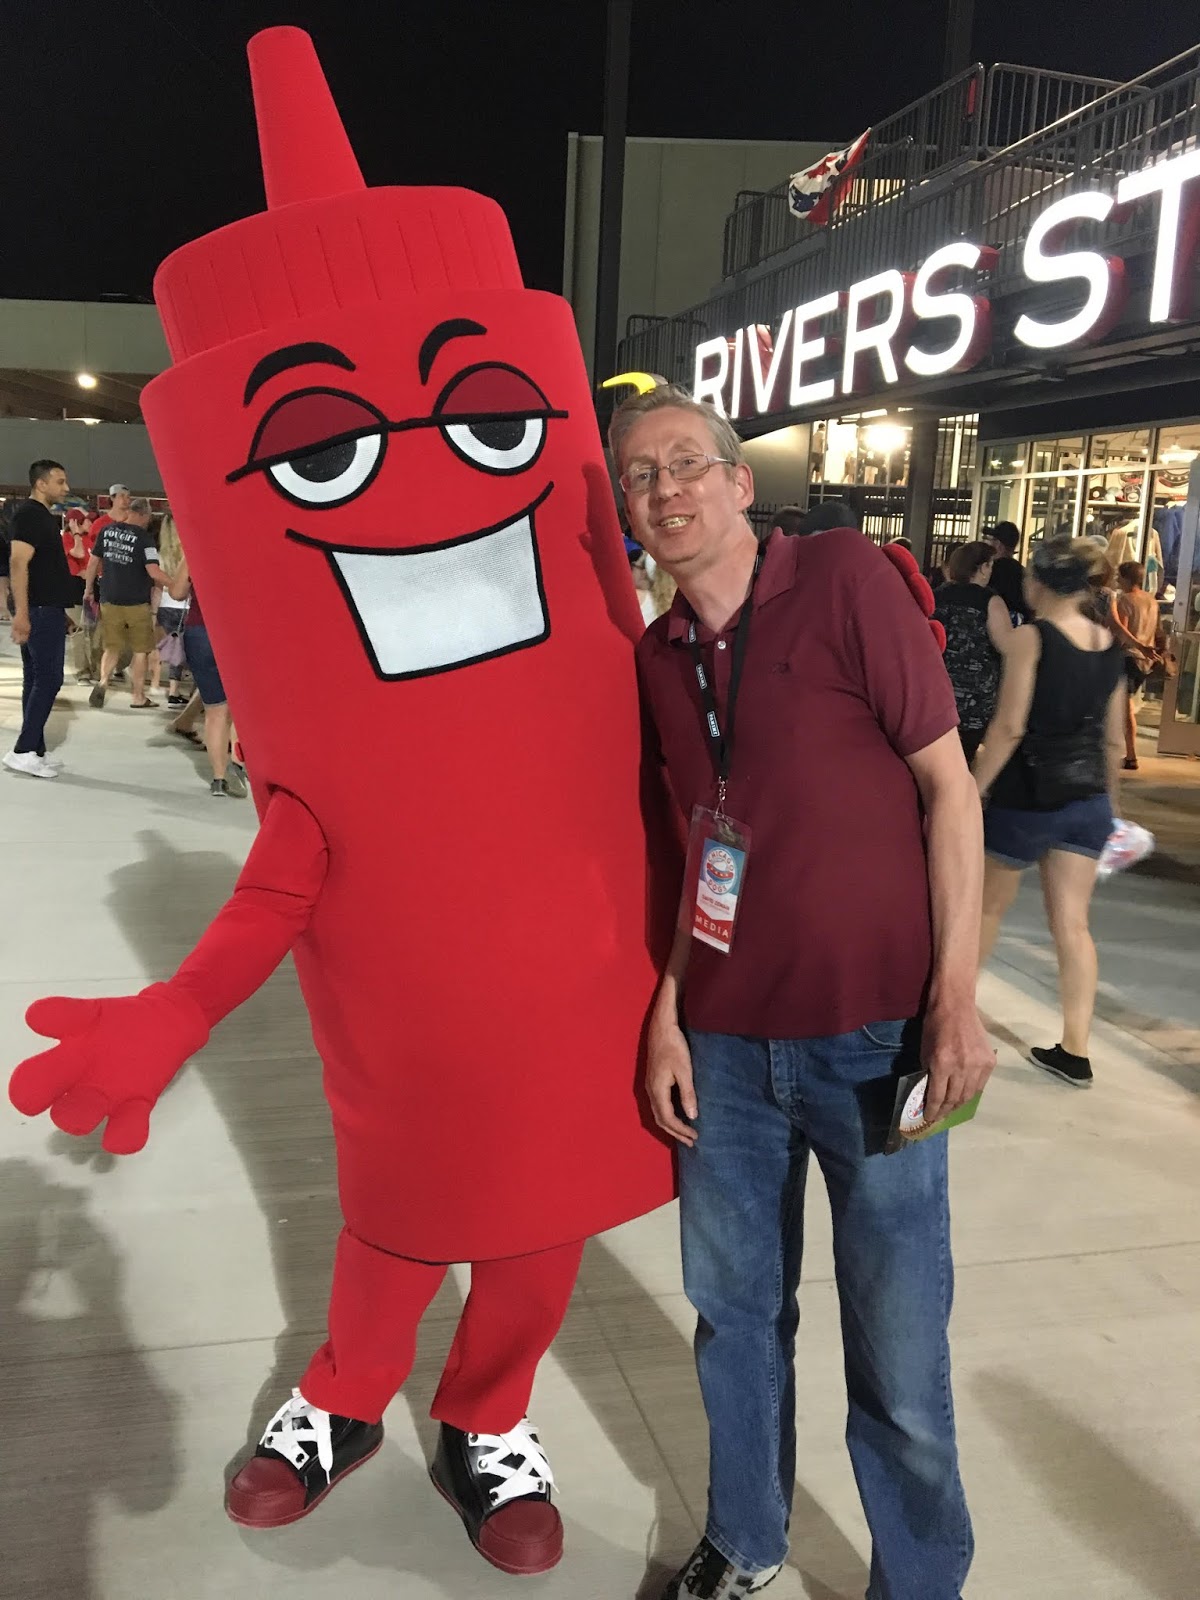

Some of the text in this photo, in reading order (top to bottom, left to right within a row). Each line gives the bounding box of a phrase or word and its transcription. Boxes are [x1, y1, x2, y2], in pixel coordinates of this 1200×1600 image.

[693, 242, 982, 419] RIVERS
[103, 530, 138, 543] FOUGHT
[707, 850, 735, 871] CHICAGO
[708, 879, 727, 892] DOGS
[695, 914, 729, 938] MEDIA
